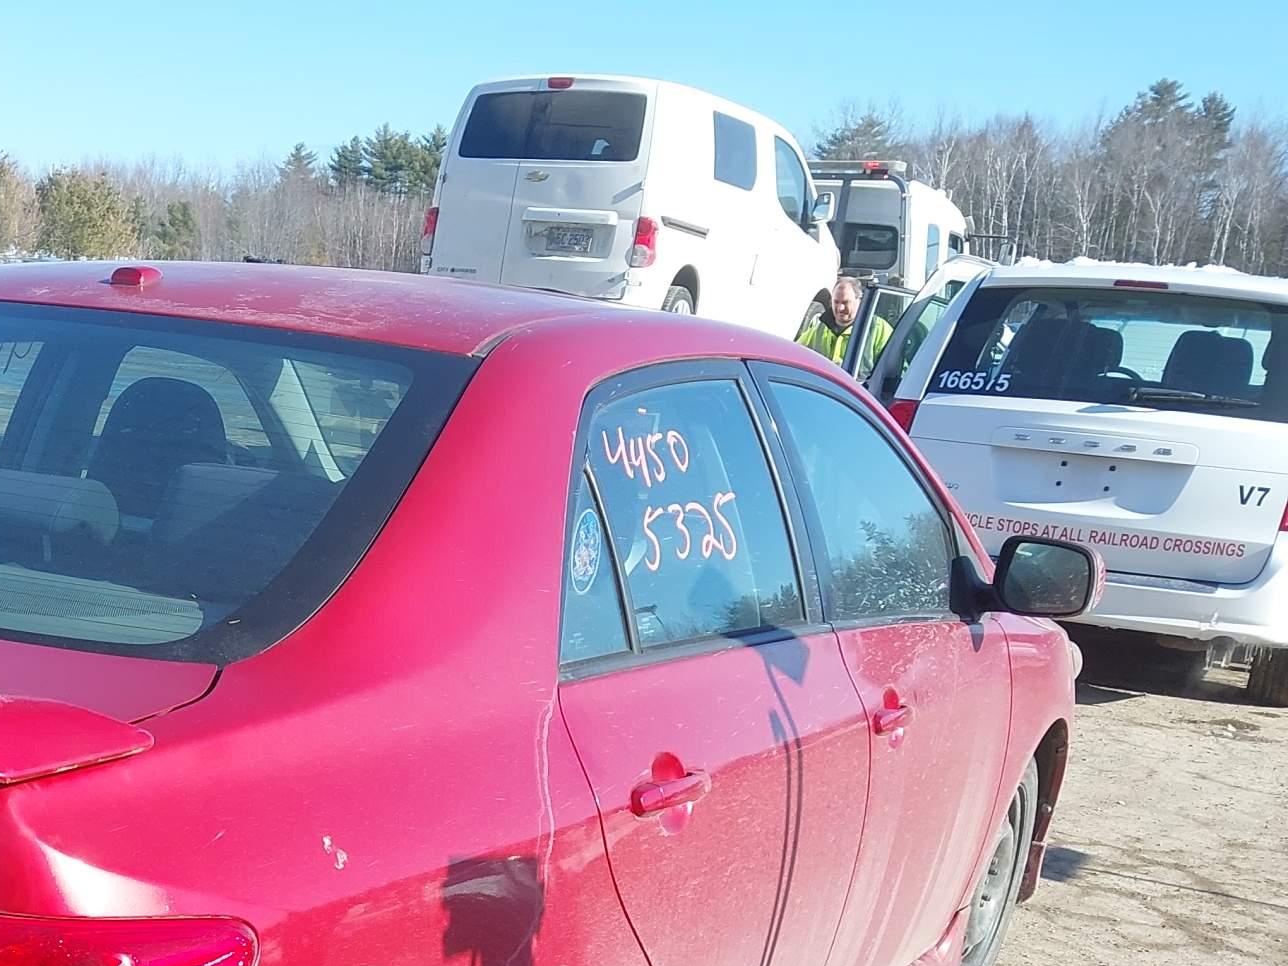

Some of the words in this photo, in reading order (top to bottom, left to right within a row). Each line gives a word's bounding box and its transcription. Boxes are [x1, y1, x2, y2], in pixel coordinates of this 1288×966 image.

[601, 426, 689, 488] 4450
[1239, 485, 1270, 506] V7
[643, 492, 737, 571] 5325
[997, 518, 1039, 536] STOPS
[1040, 524, 1059, 539] AT
[1060, 526, 1084, 542] ALL
[1088, 529, 1160, 550] RAILROAD
[1163, 537, 1246, 558] CROSSINGS
